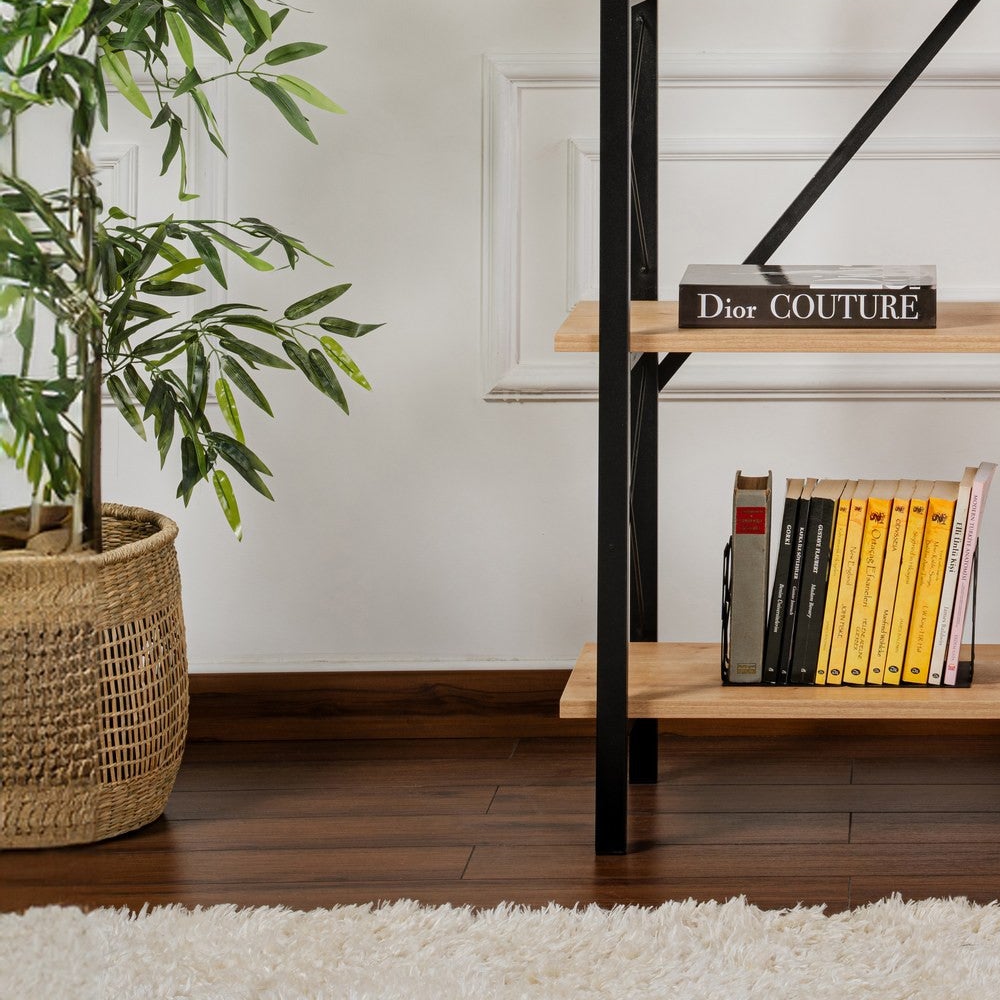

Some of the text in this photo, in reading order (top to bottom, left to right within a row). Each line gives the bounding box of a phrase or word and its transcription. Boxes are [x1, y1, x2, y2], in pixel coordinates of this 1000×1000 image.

[697, 294, 919, 320] Dior COUTURE
[955, 522, 963, 535] Elli
[813, 548, 821, 574] FLAUBERT
